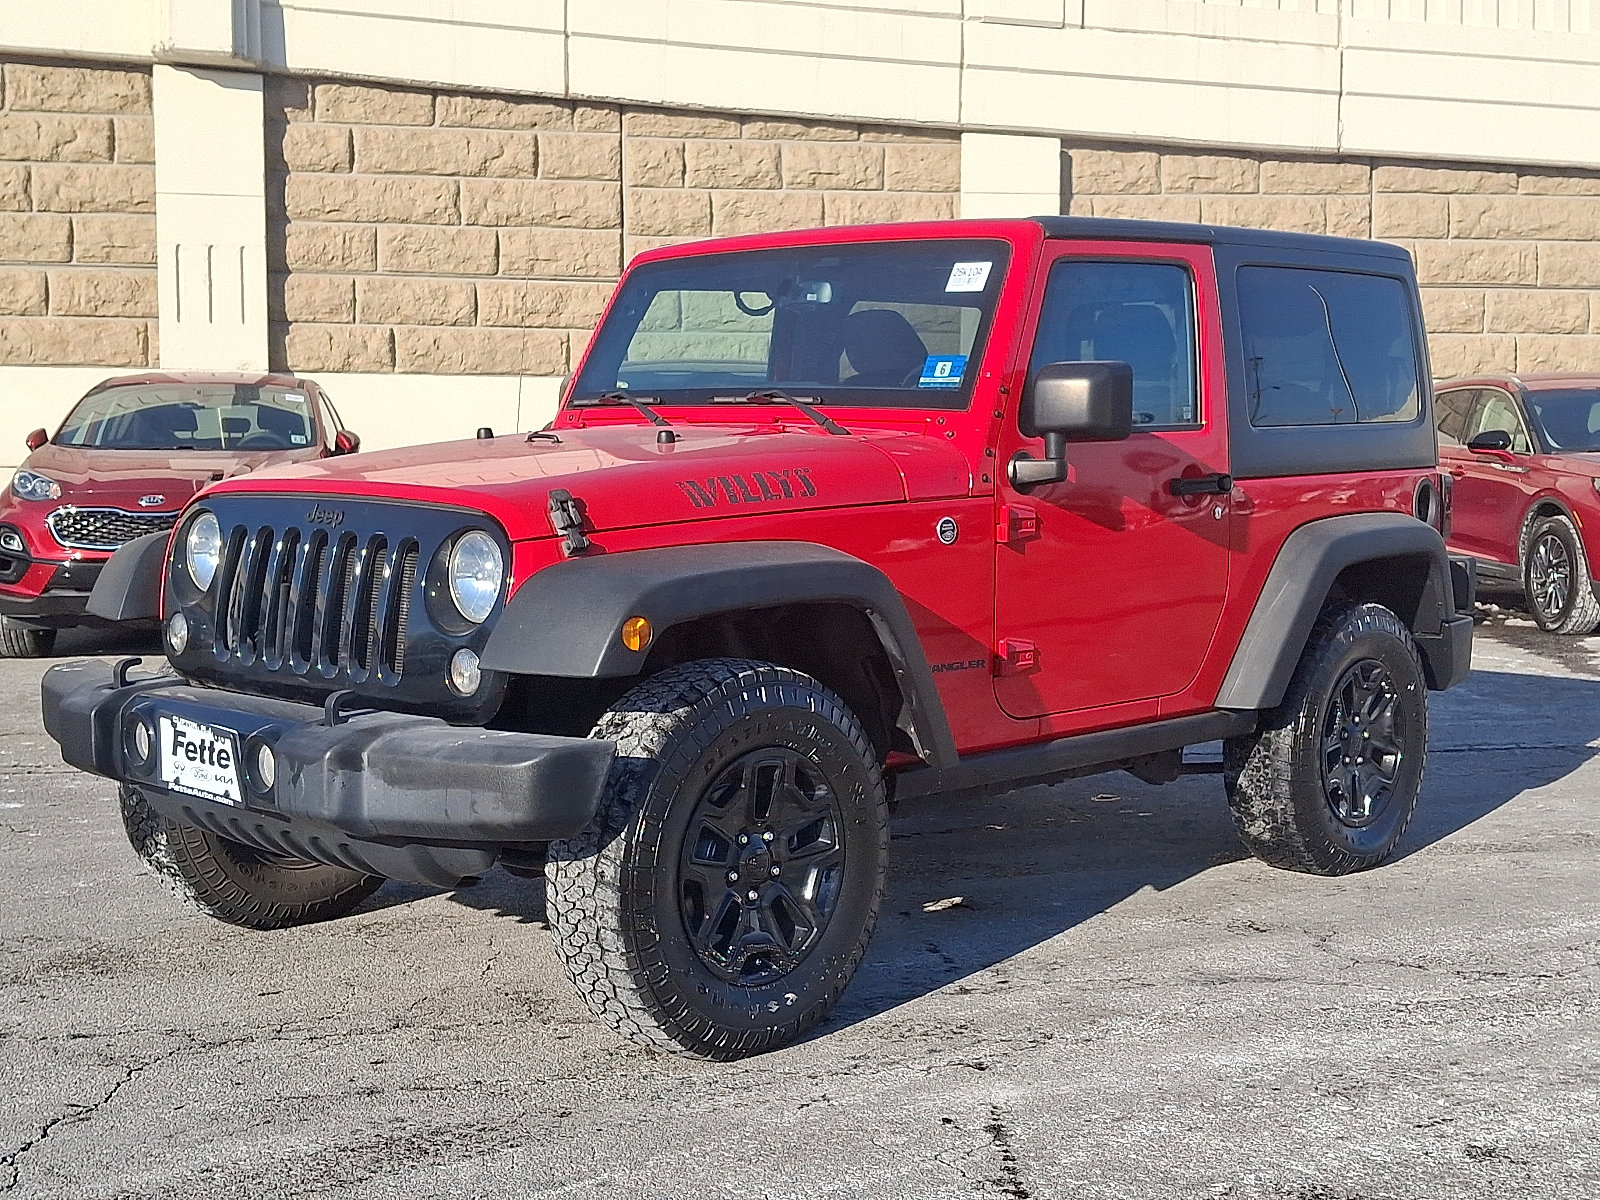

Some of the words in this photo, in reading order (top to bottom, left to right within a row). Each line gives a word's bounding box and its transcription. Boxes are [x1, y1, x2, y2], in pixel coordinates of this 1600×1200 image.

[939, 363, 947, 376] 6
[675, 467, 817, 508] WILLYS
[306, 502, 345, 530] Jeep
[931, 659, 986, 673] ANGLER
[172, 729, 231, 769] Fette
